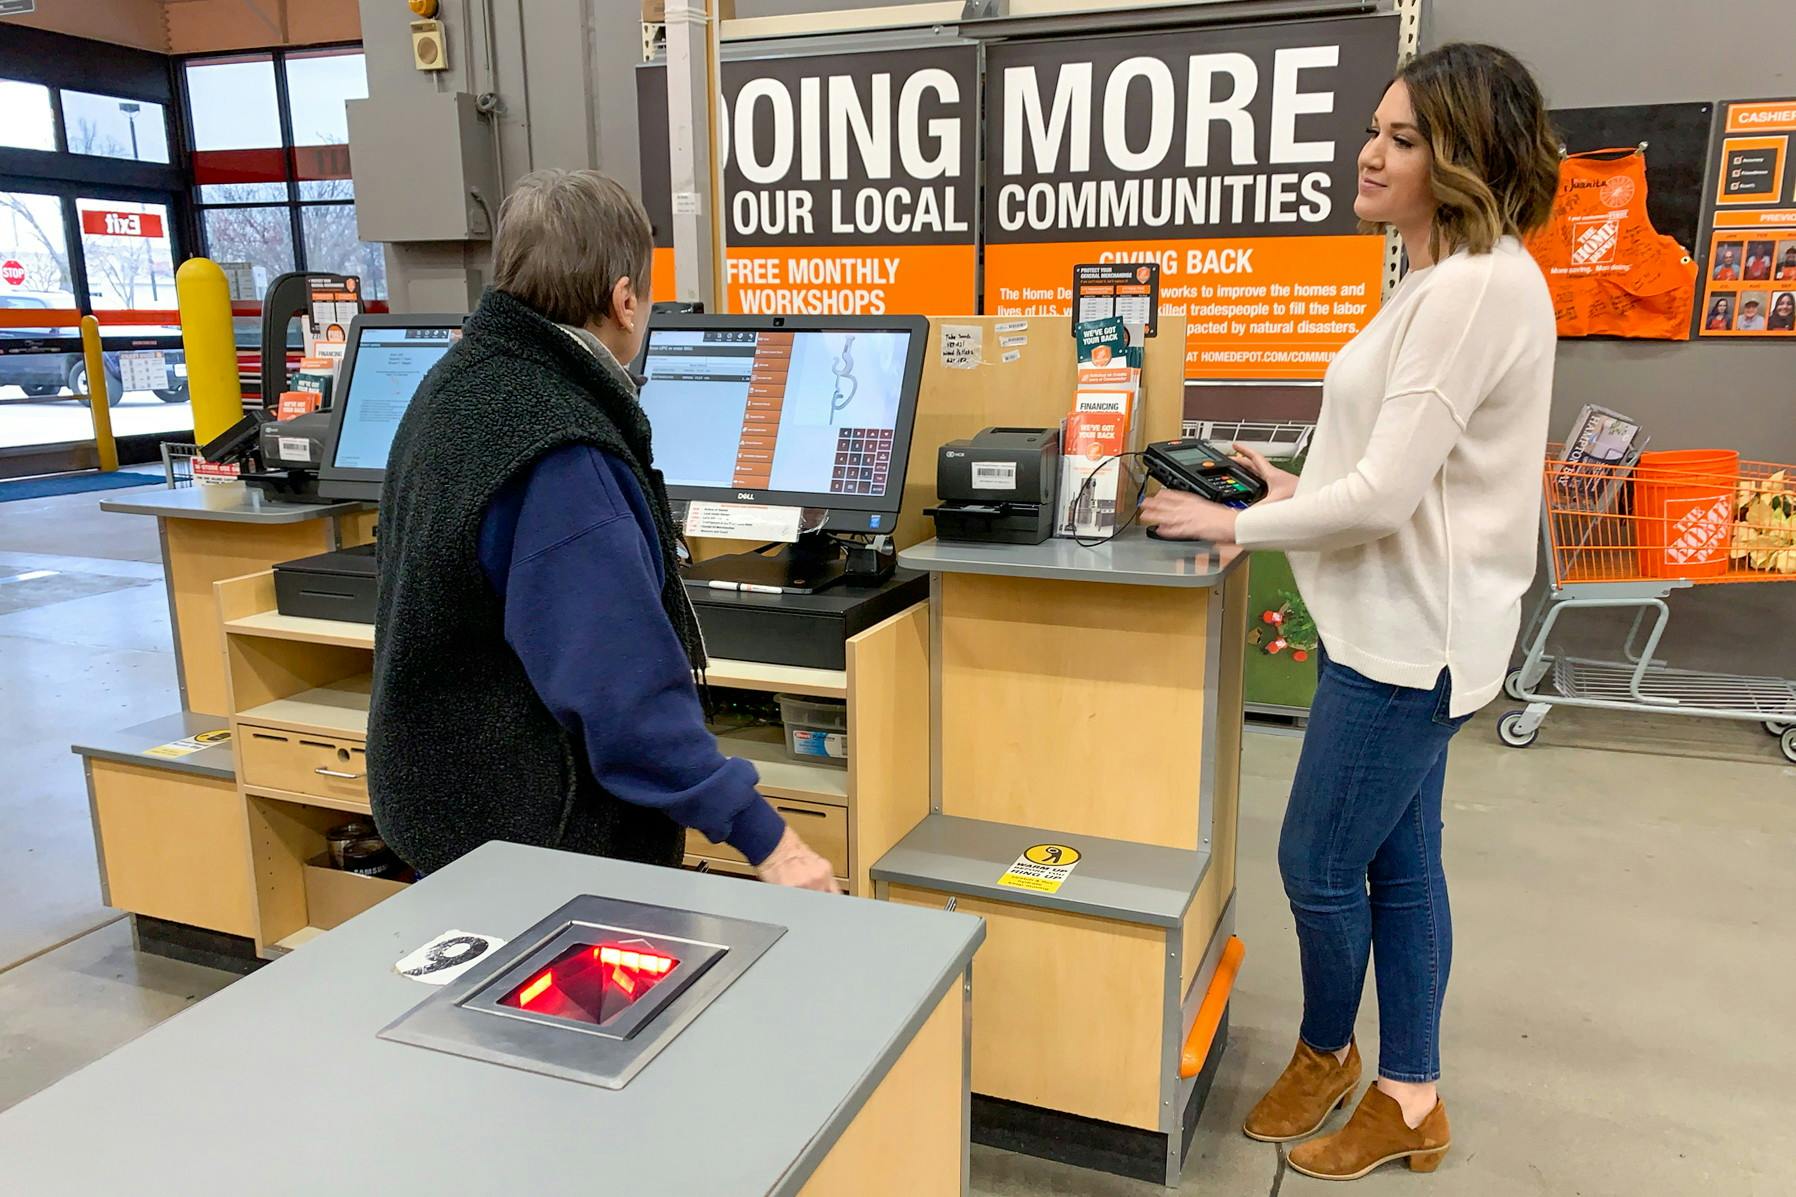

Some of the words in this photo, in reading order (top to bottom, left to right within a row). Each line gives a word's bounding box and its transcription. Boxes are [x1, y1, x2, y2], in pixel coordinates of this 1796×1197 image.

[1002, 45, 1340, 175] MORE
[720, 68, 961, 184] OING
[733, 189, 815, 235] OUR
[831, 186, 968, 234] LOCAL
[998, 172, 1332, 231] COMMUNITIES
[1573, 219, 1617, 263] HOME
[1577, 225, 1597, 244] THE
[1186, 248, 1254, 274] BACK
[3, 267, 25, 279] STOP
[727, 258, 781, 284] FREE
[788, 257, 900, 285] MONTHLY
[1000, 287, 1020, 300] The
[1023, 287, 1054, 300] Home
[1161, 285, 1198, 298] works
[1201, 286, 1214, 298] to
[1217, 284, 1267, 300] improve
[1270, 283, 1290, 297] the
[1294, 283, 1337, 297] homes
[1340, 282, 1365, 296] and
[739, 288, 886, 315] WORKSHOPS
[998, 305, 1022, 317] lives
[1025, 304, 1037, 317] of
[1191, 303, 1269, 319] tradespeople
[1273, 303, 1286, 316] to
[1289, 302, 1305, 315] fill
[1309, 302, 1329, 315] the
[1333, 302, 1367, 315] labor
[1083, 327, 1103, 338] WE'VE
[1104, 326, 1117, 336] GOT
[1231, 321, 1245, 336] by
[1250, 320, 1294, 334] natural
[1297, 320, 1360, 334] disasters.
[1083, 336, 1100, 346] YOUR
[1101, 334, 1118, 343] BACK
[1186, 352, 1198, 362] AT
[1080, 402, 1119, 411] FINANCING
[1079, 431, 1097, 439] YOUR
[1097, 431, 1116, 440] BACK
[1100, 424, 1115, 432] GOT
[737, 492, 754, 500] DELL
[1673, 507, 1705, 532] THE
[1667, 496, 1728, 564] HOME
